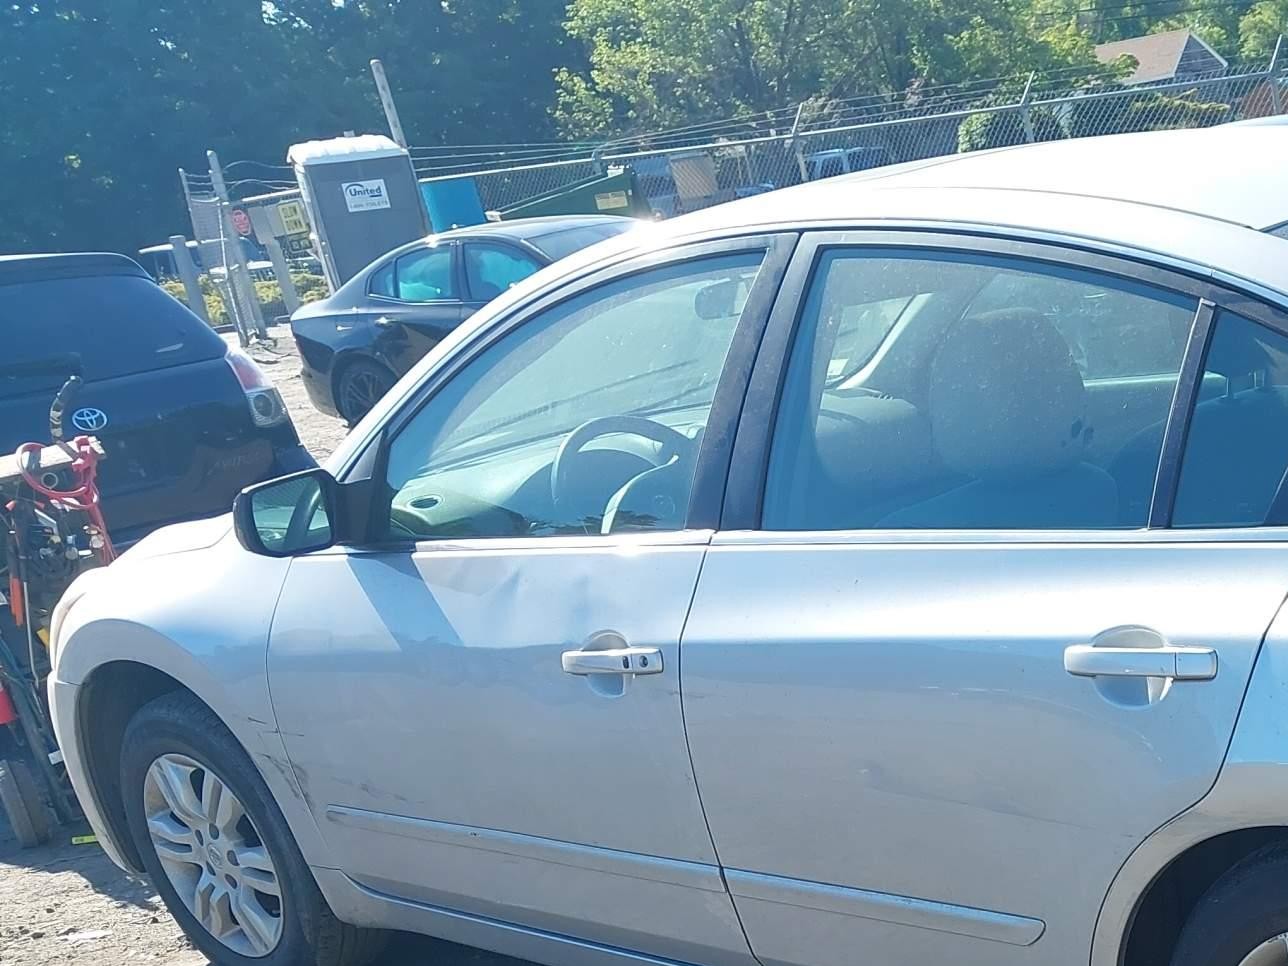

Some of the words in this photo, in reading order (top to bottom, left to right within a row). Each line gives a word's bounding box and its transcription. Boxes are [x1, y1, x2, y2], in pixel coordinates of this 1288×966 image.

[349, 185, 382, 197] United
[281, 205, 298, 219] SLOW
[285, 218, 304, 232] DOWN
